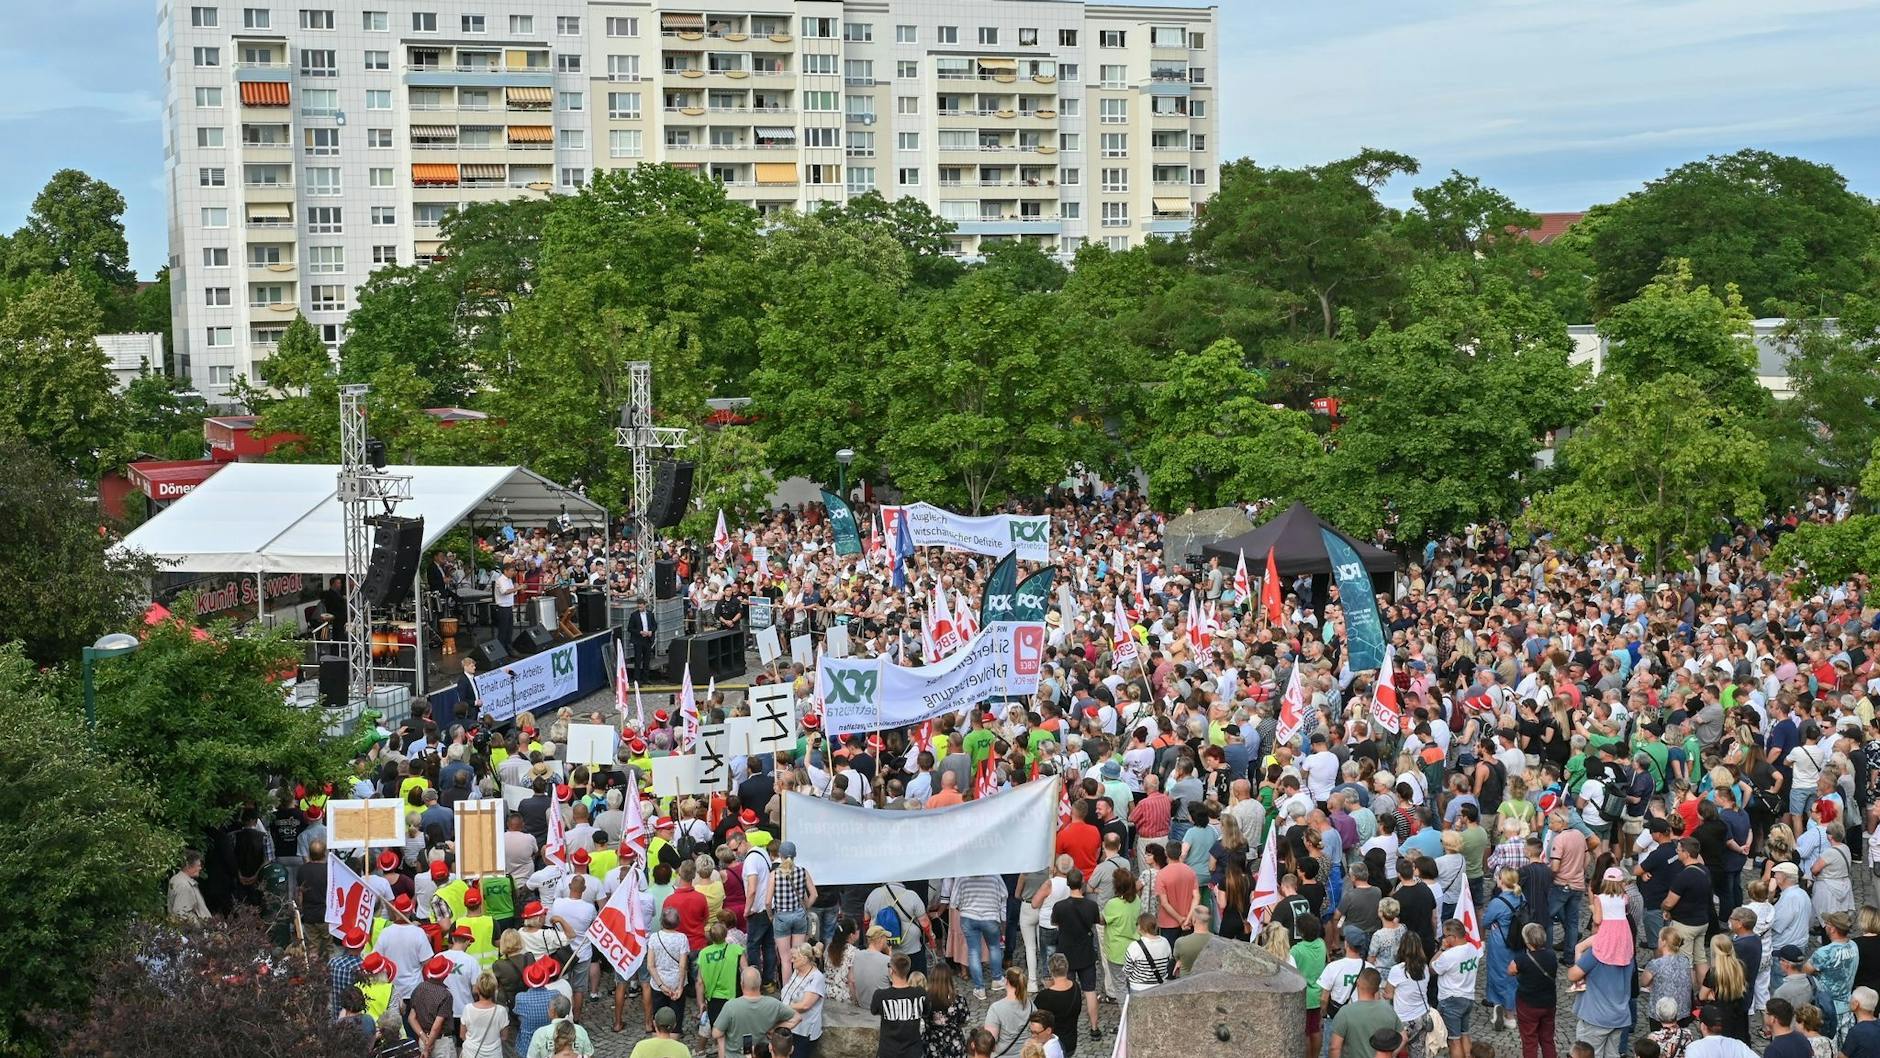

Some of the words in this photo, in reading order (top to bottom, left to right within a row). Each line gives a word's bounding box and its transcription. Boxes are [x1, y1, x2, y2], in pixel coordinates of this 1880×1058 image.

[159, 482, 197, 496] Döner
[973, 535, 1003, 549] Defizite
[1009, 520, 1049, 543] PCK
[196, 580, 239, 615] kunft
[988, 594, 1013, 612] PCK
[1017, 592, 1045, 610] PCK
[551, 646, 574, 679] PCK
[480, 678, 499, 696] Erhalt
[522, 664, 545, 680] Arbeits-
[495, 683, 546, 708] Ausbidungsplätze
[1373, 701, 1399, 729] BCE
[486, 884, 510, 897] PCK
[588, 920, 634, 972] IGBCE
[1459, 956, 1478, 974] PCK
[1343, 974, 1359, 987] PC
[882, 995, 926, 1021] ADIDAS
